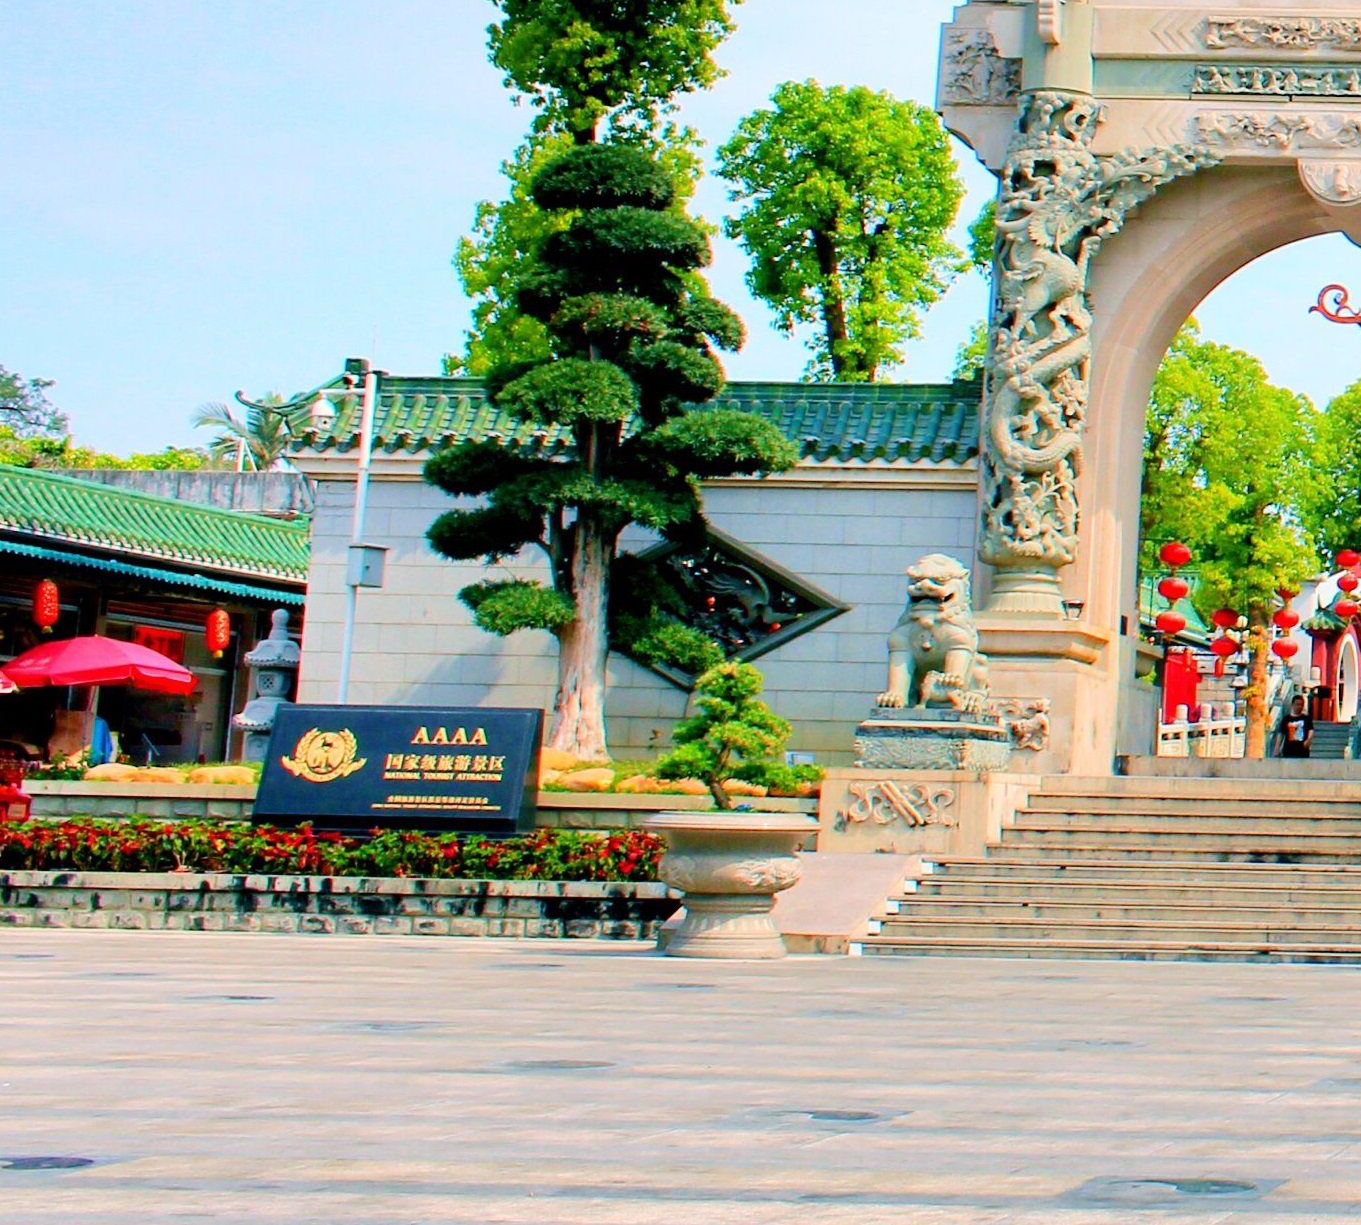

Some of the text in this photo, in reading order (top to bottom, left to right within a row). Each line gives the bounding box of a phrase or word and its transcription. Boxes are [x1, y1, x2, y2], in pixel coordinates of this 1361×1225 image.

[411, 725, 488, 745] AAAA
[384, 753, 506, 772] 国家级旅游景区
[383, 771, 503, 782] NATIONAL TOURIST ATTRACTION
